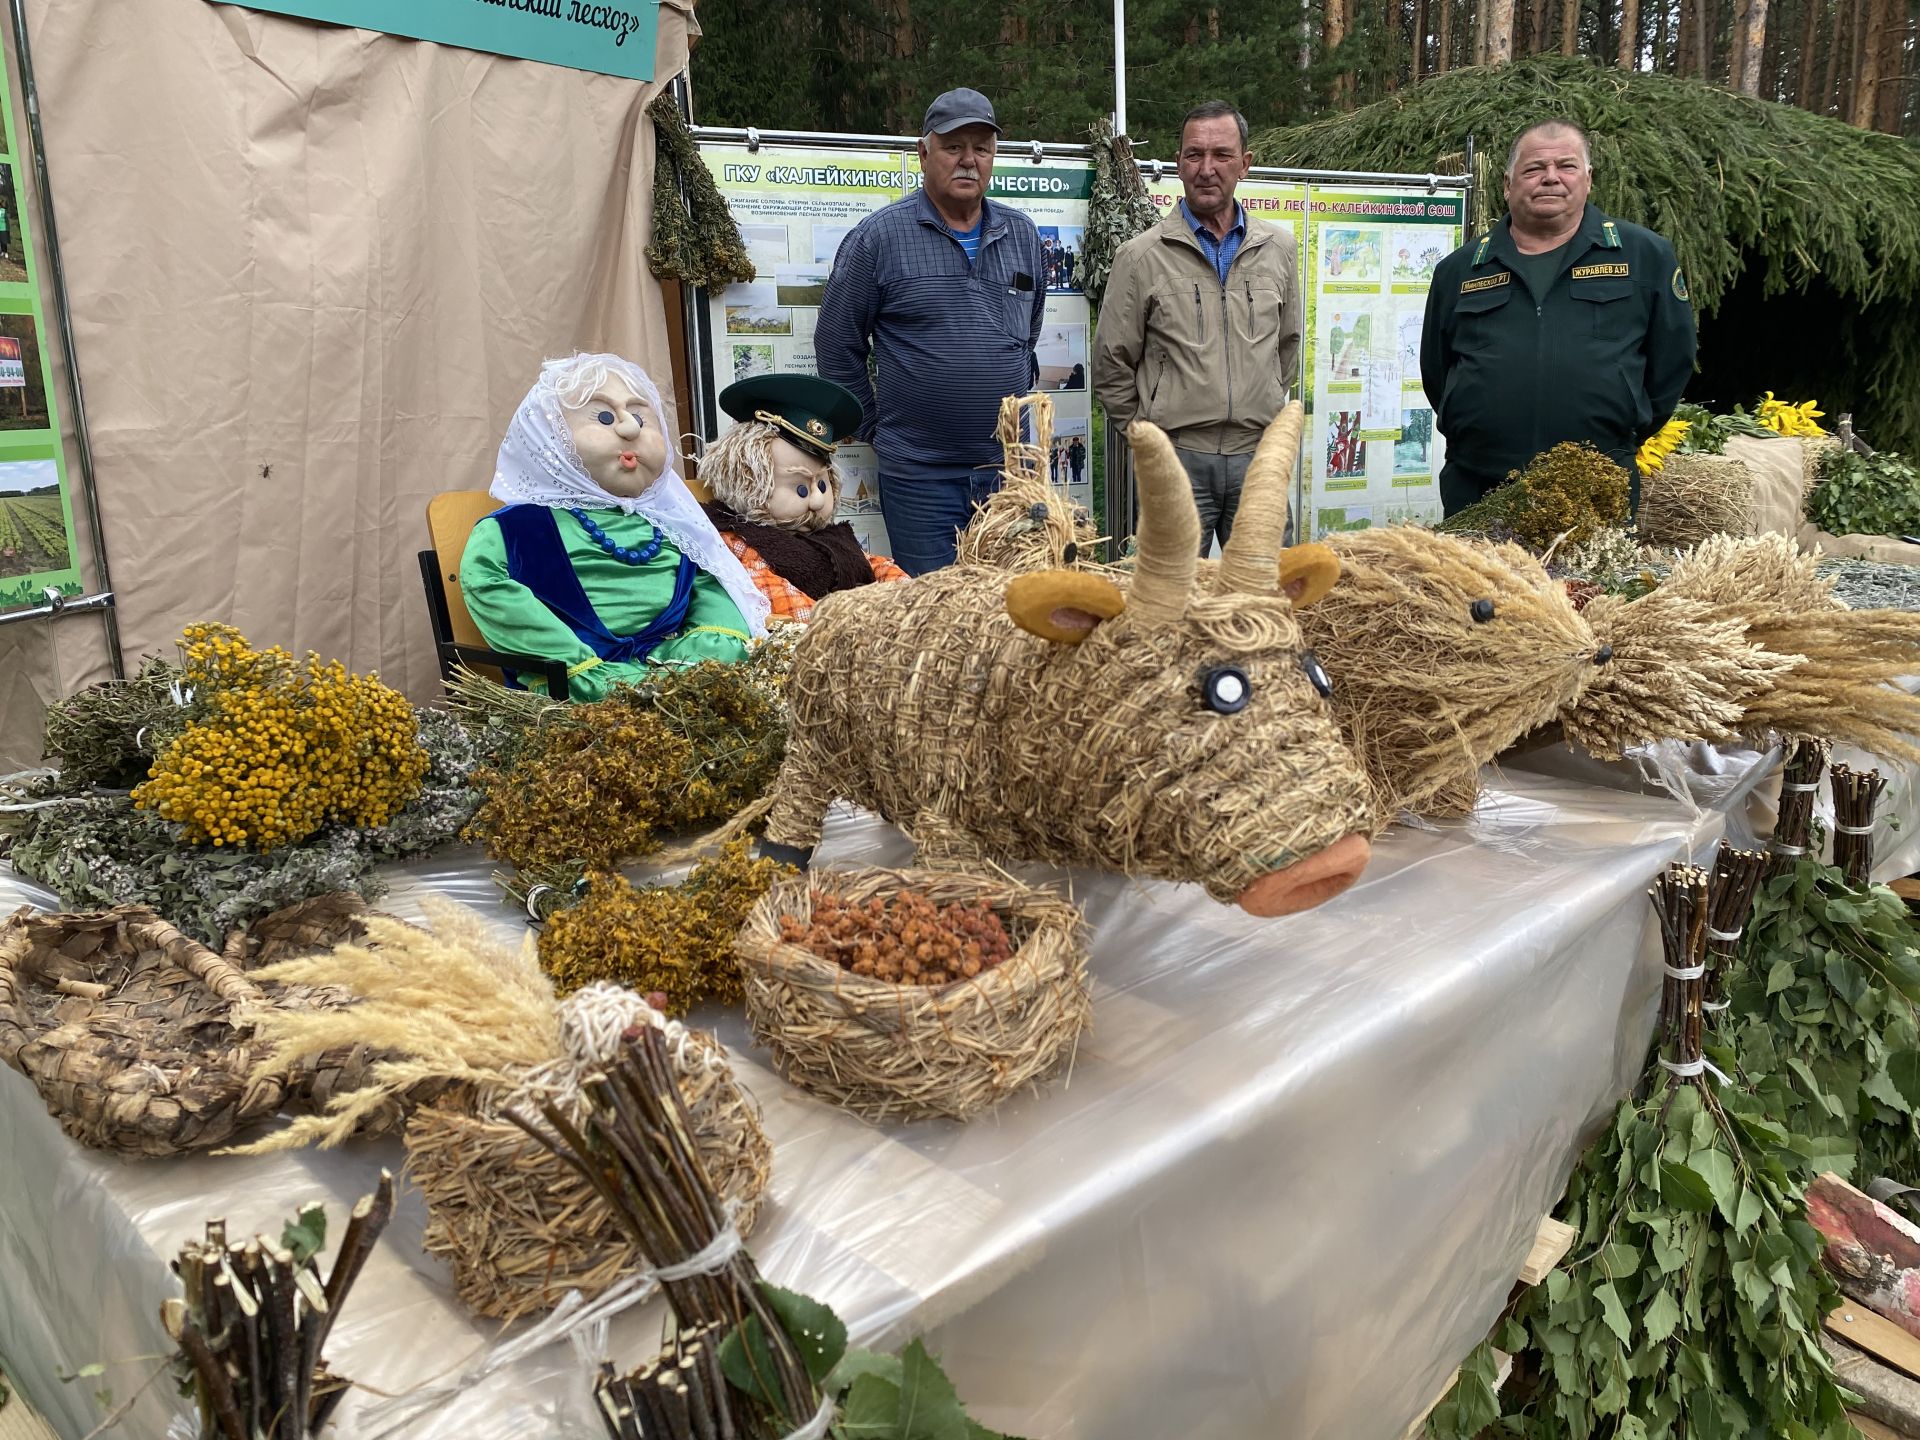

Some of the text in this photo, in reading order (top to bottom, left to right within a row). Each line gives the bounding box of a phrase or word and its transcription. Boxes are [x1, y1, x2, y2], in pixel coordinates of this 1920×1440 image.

[567, 1, 640, 46] лесхоз»
[724, 164, 1070, 193] ГКУ «КАЛЕЙКИНСКОЕ ИЧЕСТВО»
[1241, 198, 1280, 211] ДЕТЕЙ
[1428, 204, 1456, 216] СОШ
[1574, 266, 1613, 276] ЖУРАВЛЕВ
